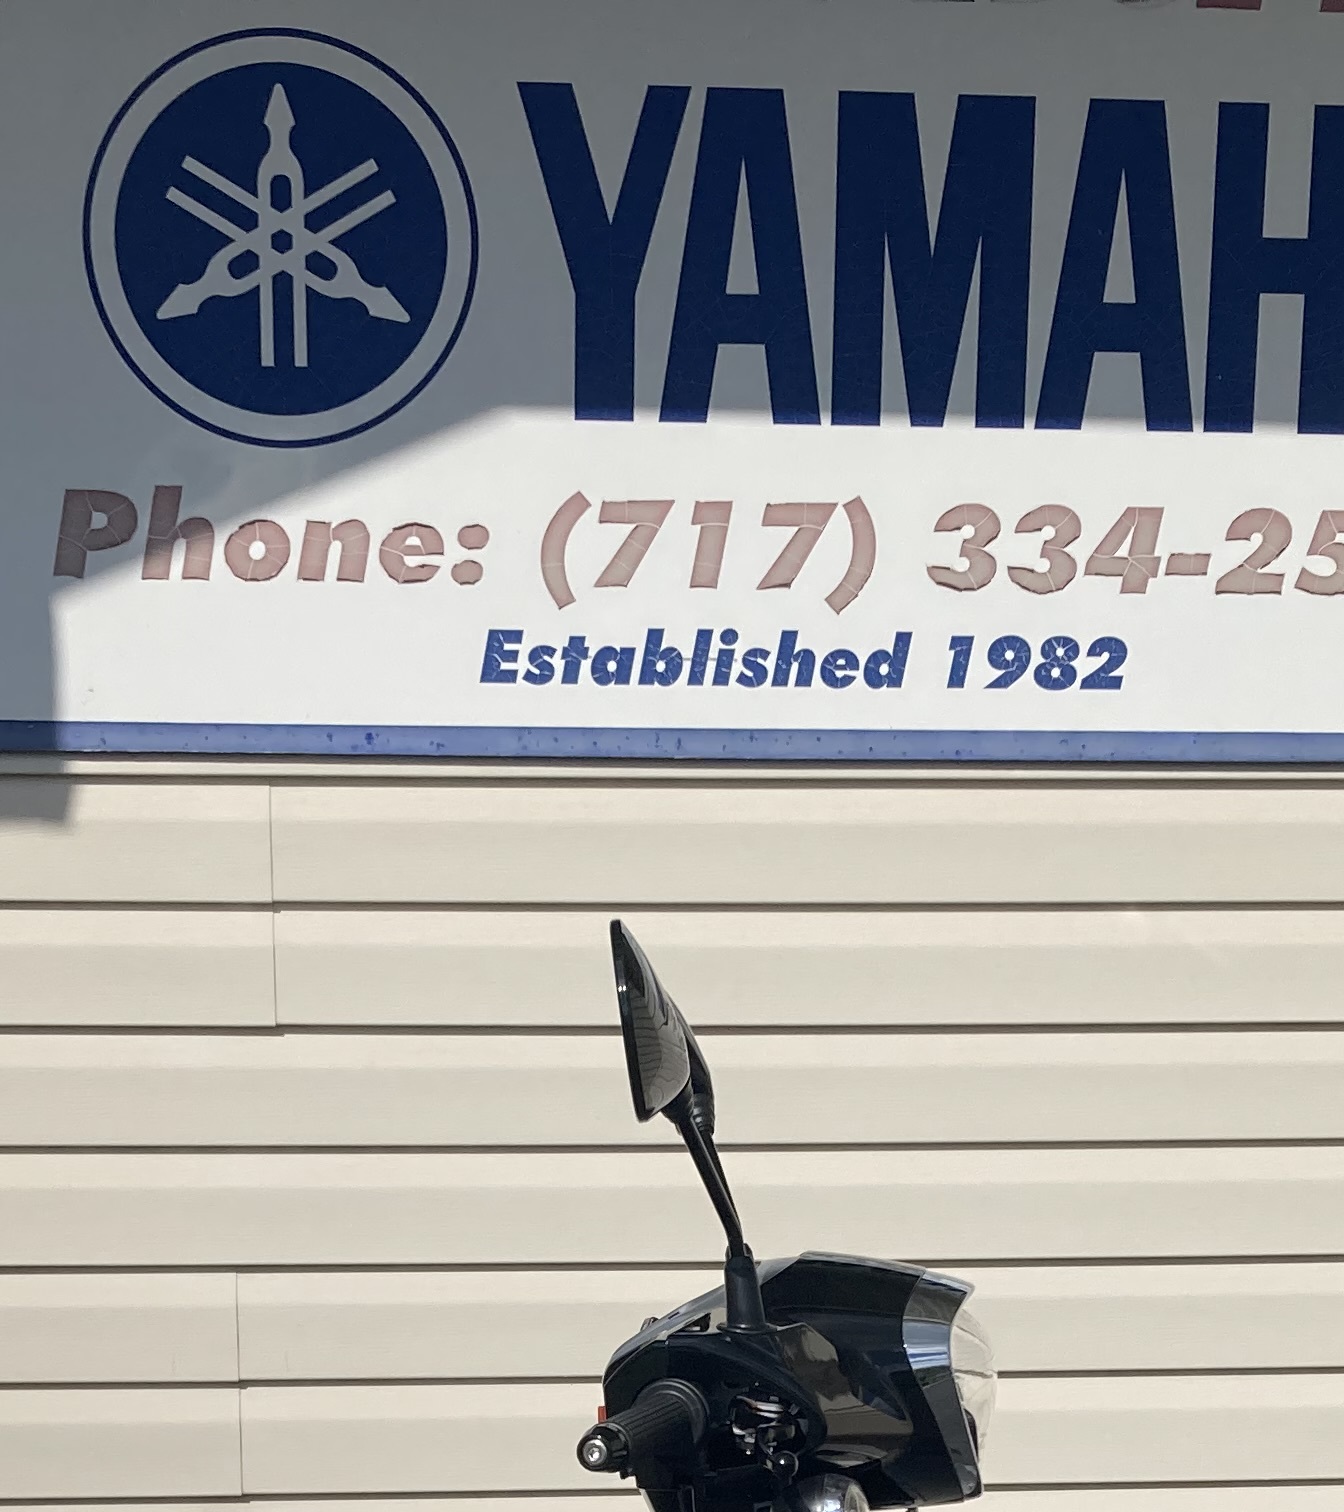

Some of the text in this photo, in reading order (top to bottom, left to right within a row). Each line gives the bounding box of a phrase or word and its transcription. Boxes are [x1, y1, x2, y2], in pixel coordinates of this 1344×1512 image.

[53, 484, 490, 587] Phone:
[540, 490, 878, 615] (717)
[479, 628, 1129, 692] Established 1982
